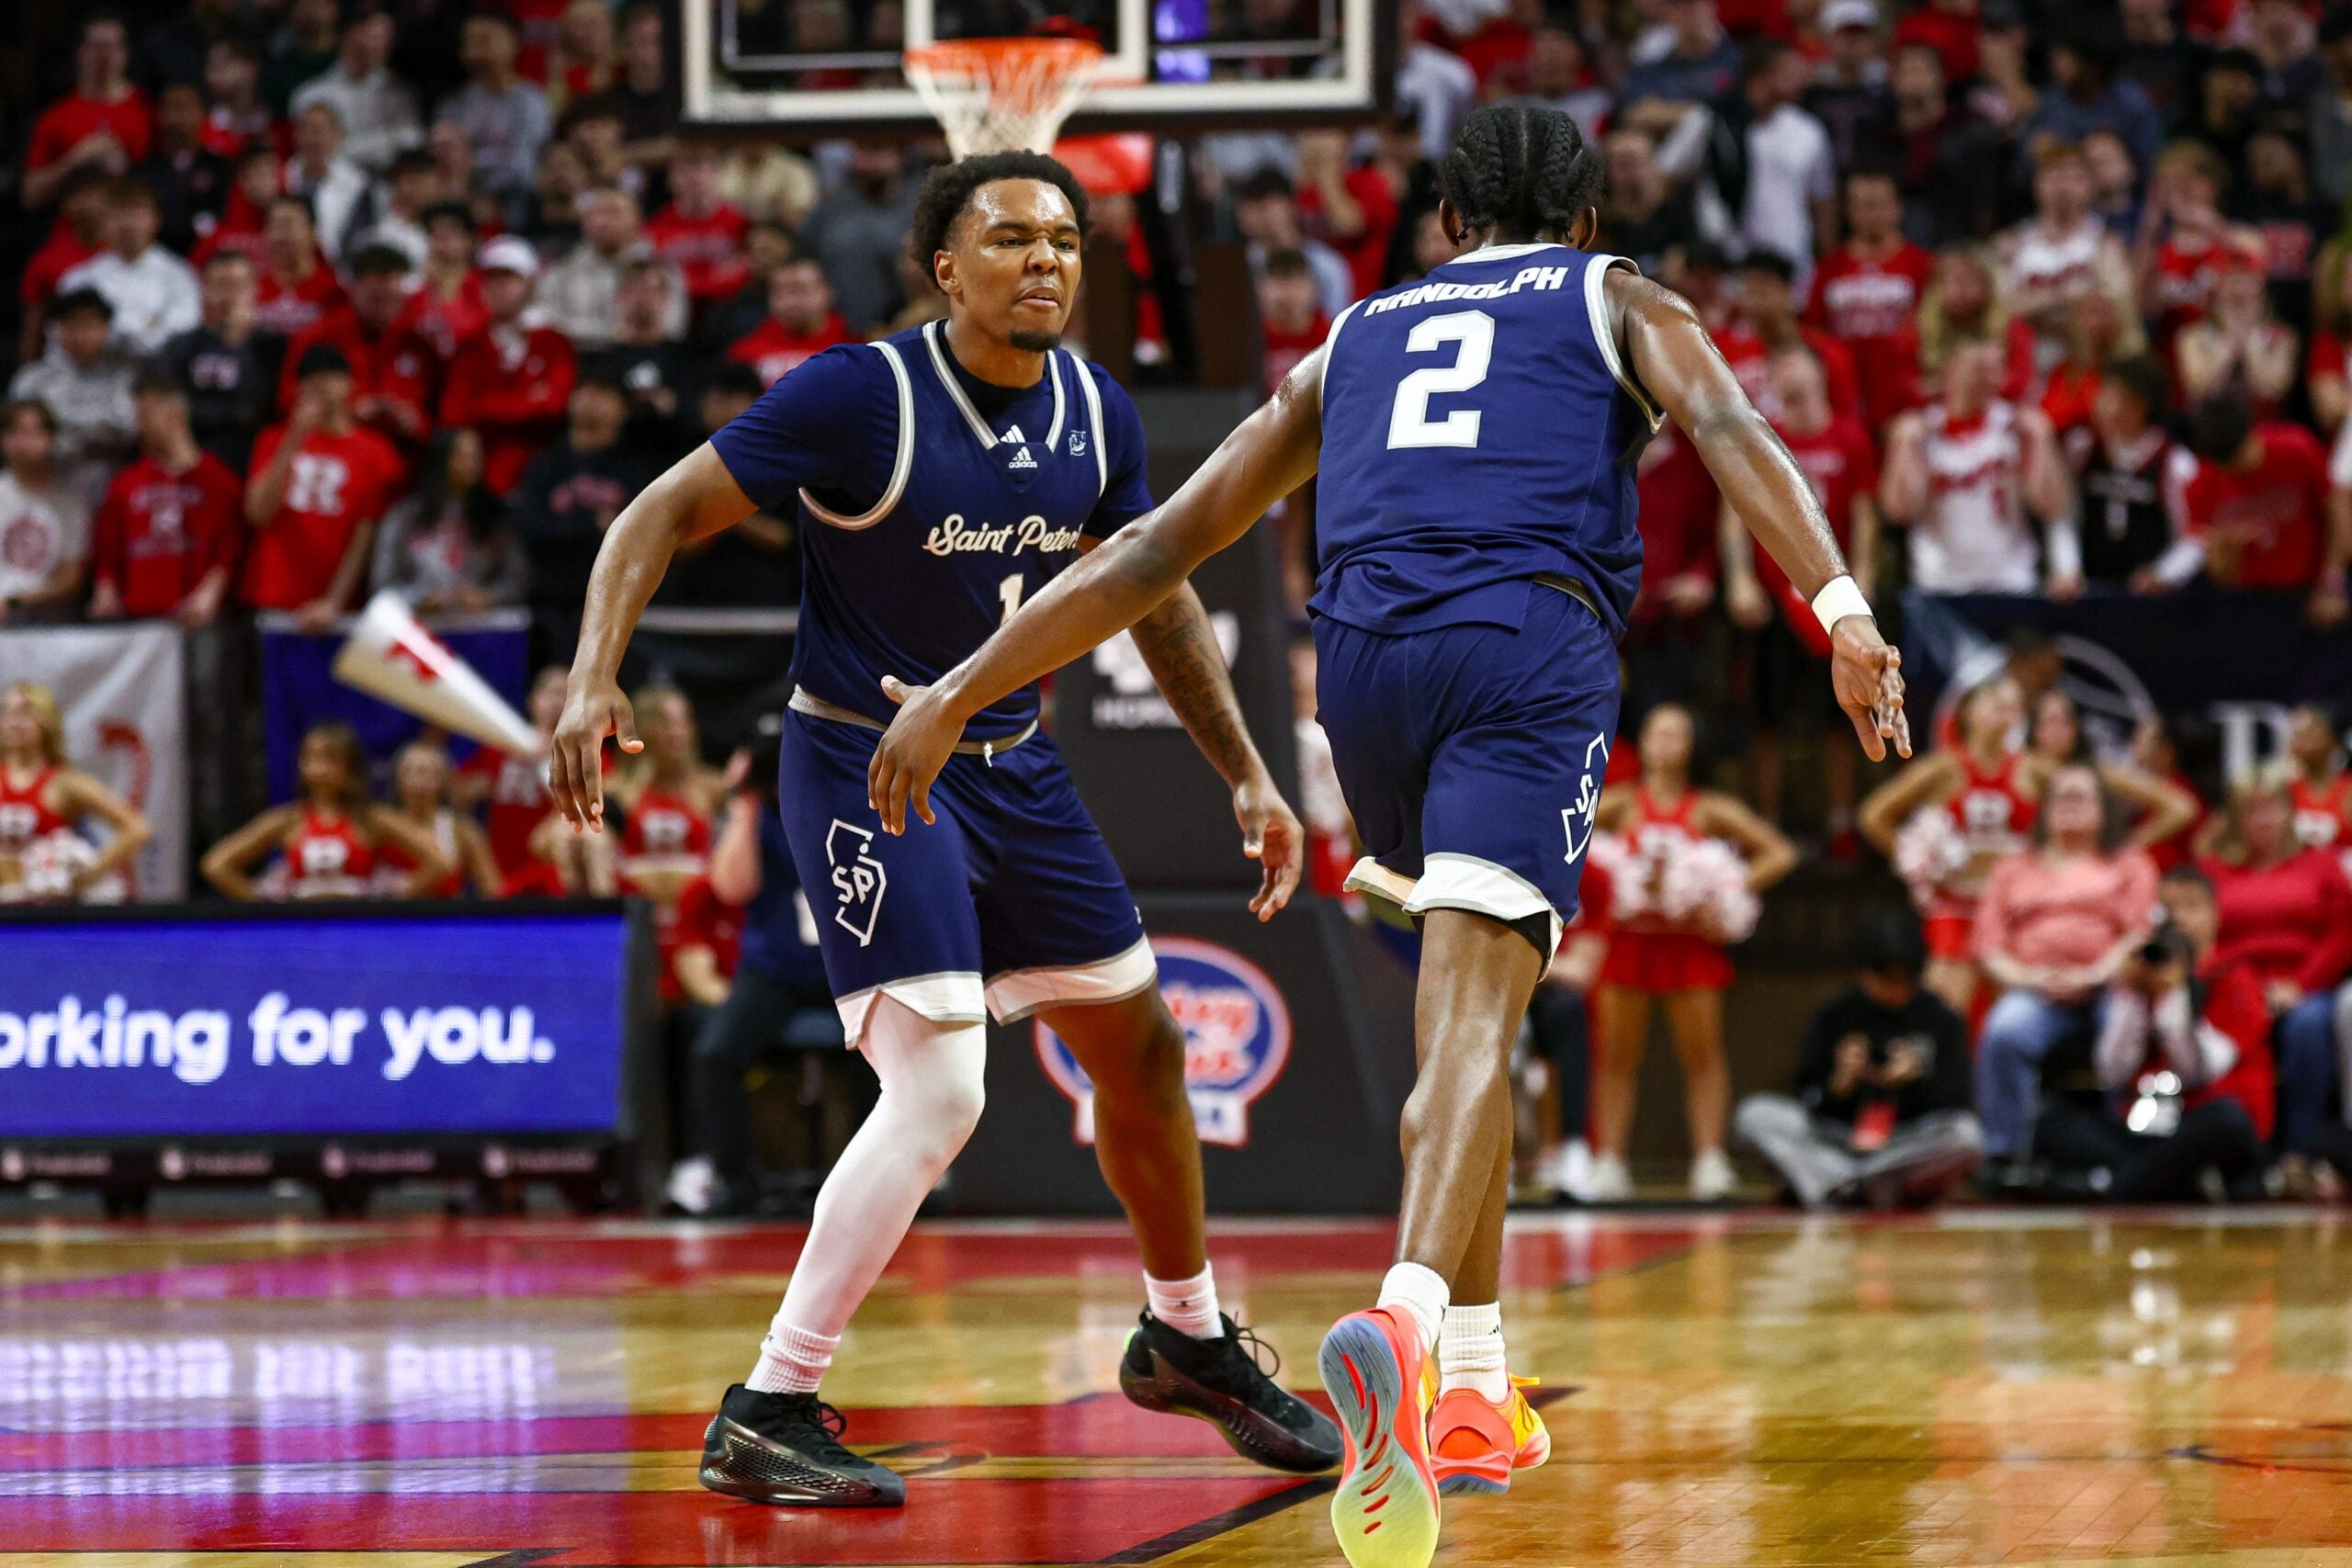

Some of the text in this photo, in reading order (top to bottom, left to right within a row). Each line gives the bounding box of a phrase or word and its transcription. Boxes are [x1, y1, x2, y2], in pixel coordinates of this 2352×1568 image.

[1386, 310, 1496, 449] 2
[922, 513, 1014, 557] Saint
[831, 865, 875, 904] SP
[248, 990, 367, 1066] for
[380, 1006, 555, 1080] you.
